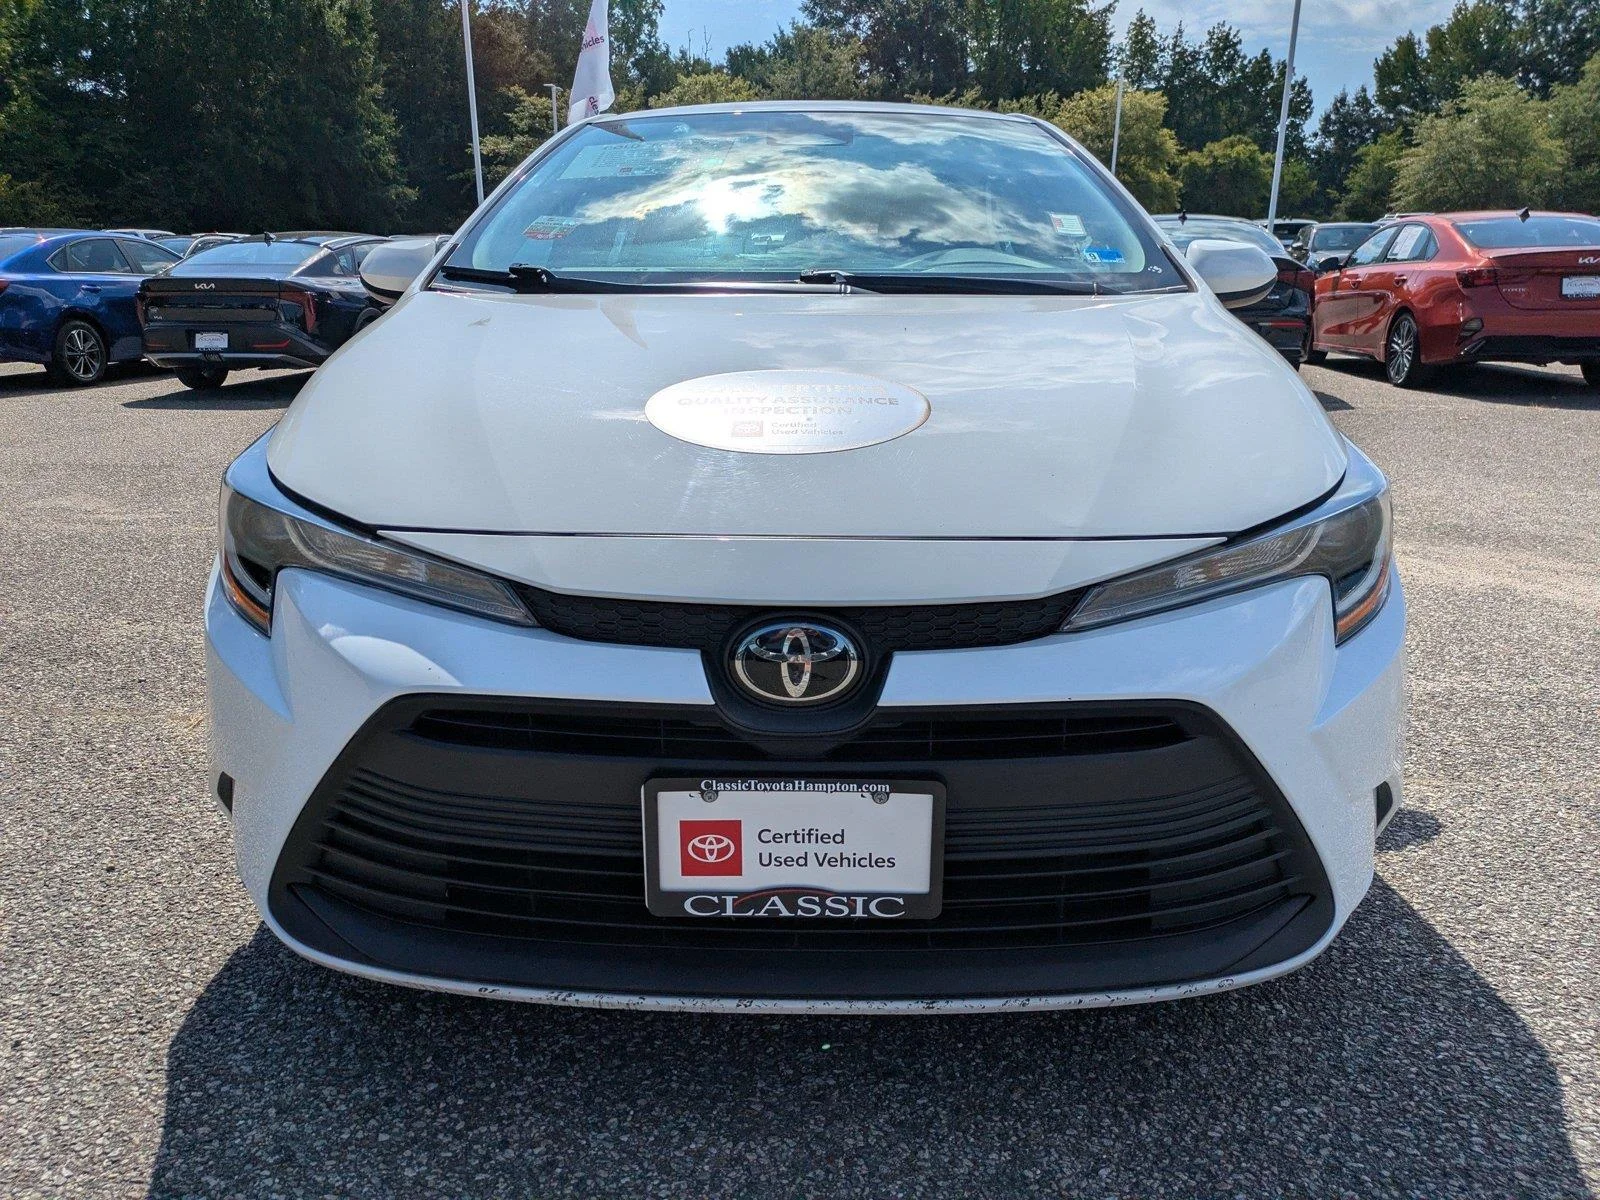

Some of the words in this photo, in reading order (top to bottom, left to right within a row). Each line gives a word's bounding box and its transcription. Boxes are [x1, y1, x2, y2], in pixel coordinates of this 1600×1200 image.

[677, 396, 767, 406] QUALITY
[701, 779, 890, 793] ClassicToyotaHampton.com
[757, 828, 845, 845] Certified
[758, 851, 808, 867] Used
[814, 852, 896, 868] Vehicles
[684, 895, 906, 918] CLASSIC
